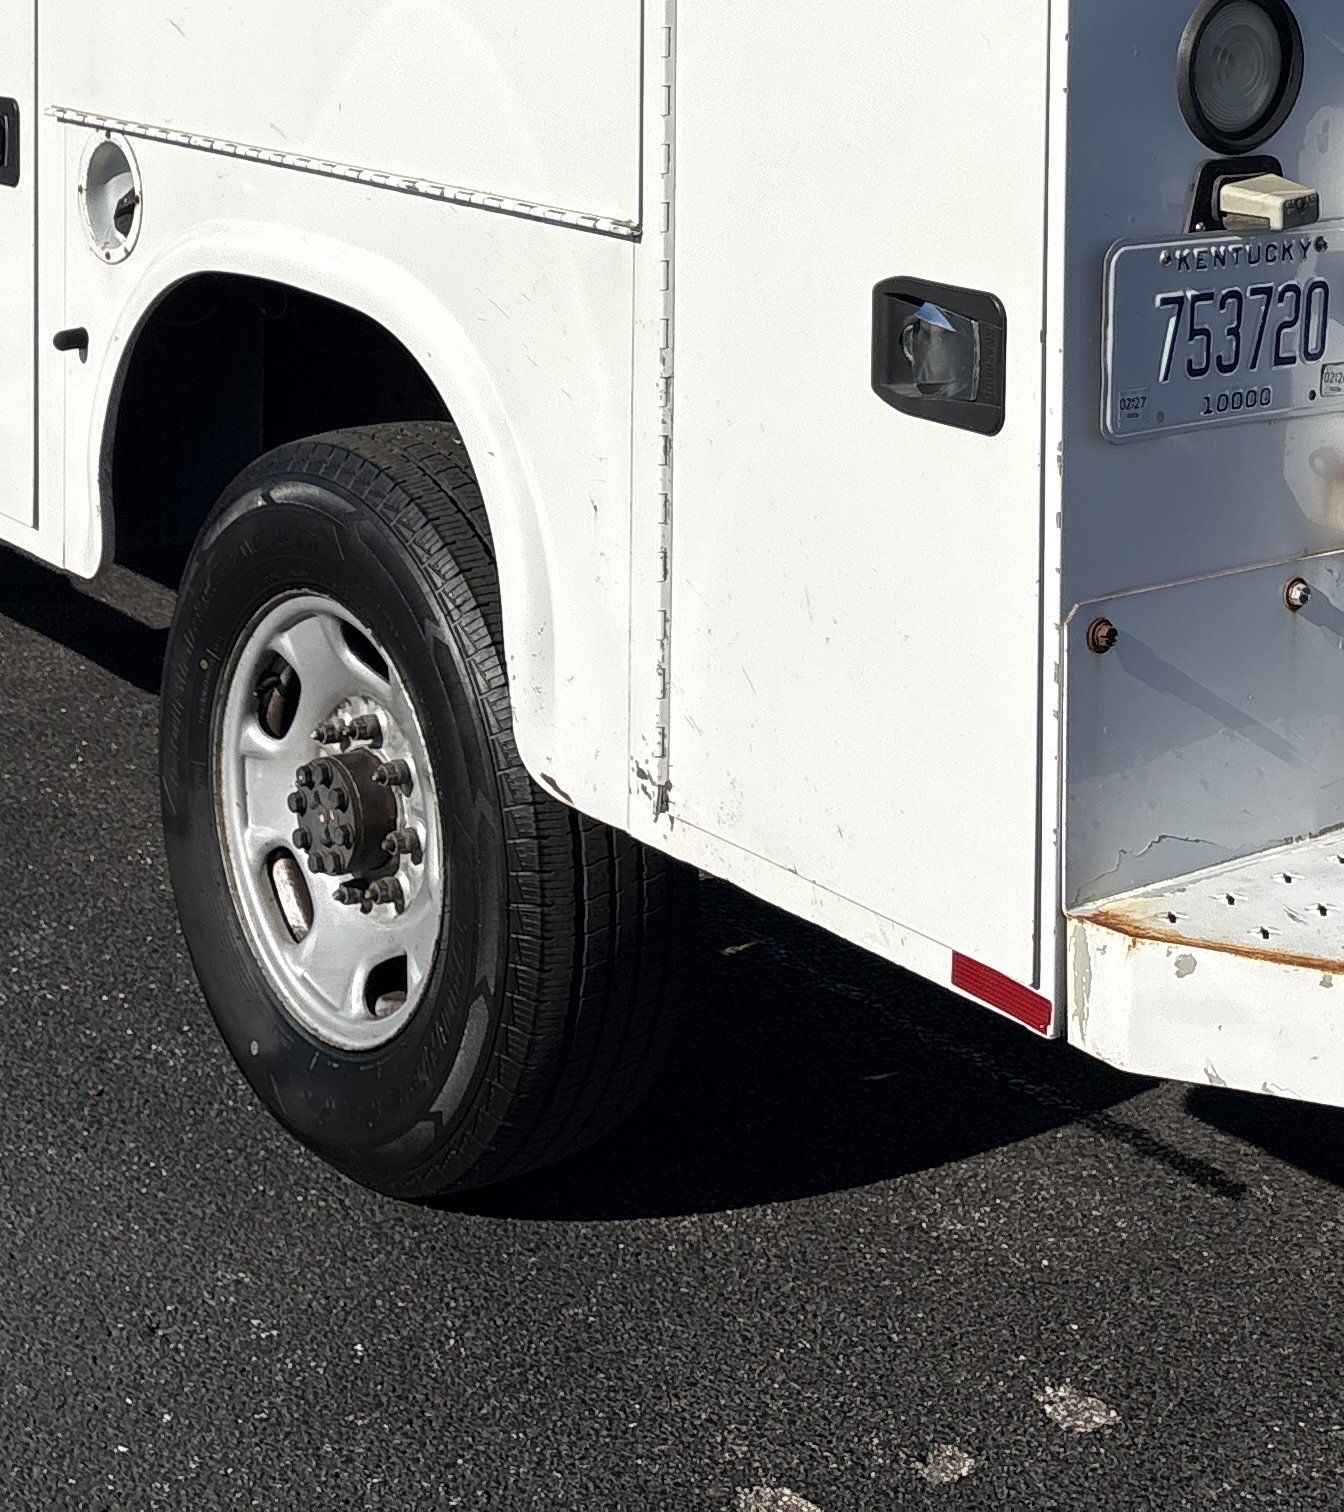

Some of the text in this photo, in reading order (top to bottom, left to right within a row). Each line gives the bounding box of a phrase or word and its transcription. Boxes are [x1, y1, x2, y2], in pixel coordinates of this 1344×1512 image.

[1175, 238, 1313, 271] KENTUCKY
[1156, 278, 1330, 384] 753720
[1201, 386, 1273, 416] 10000
